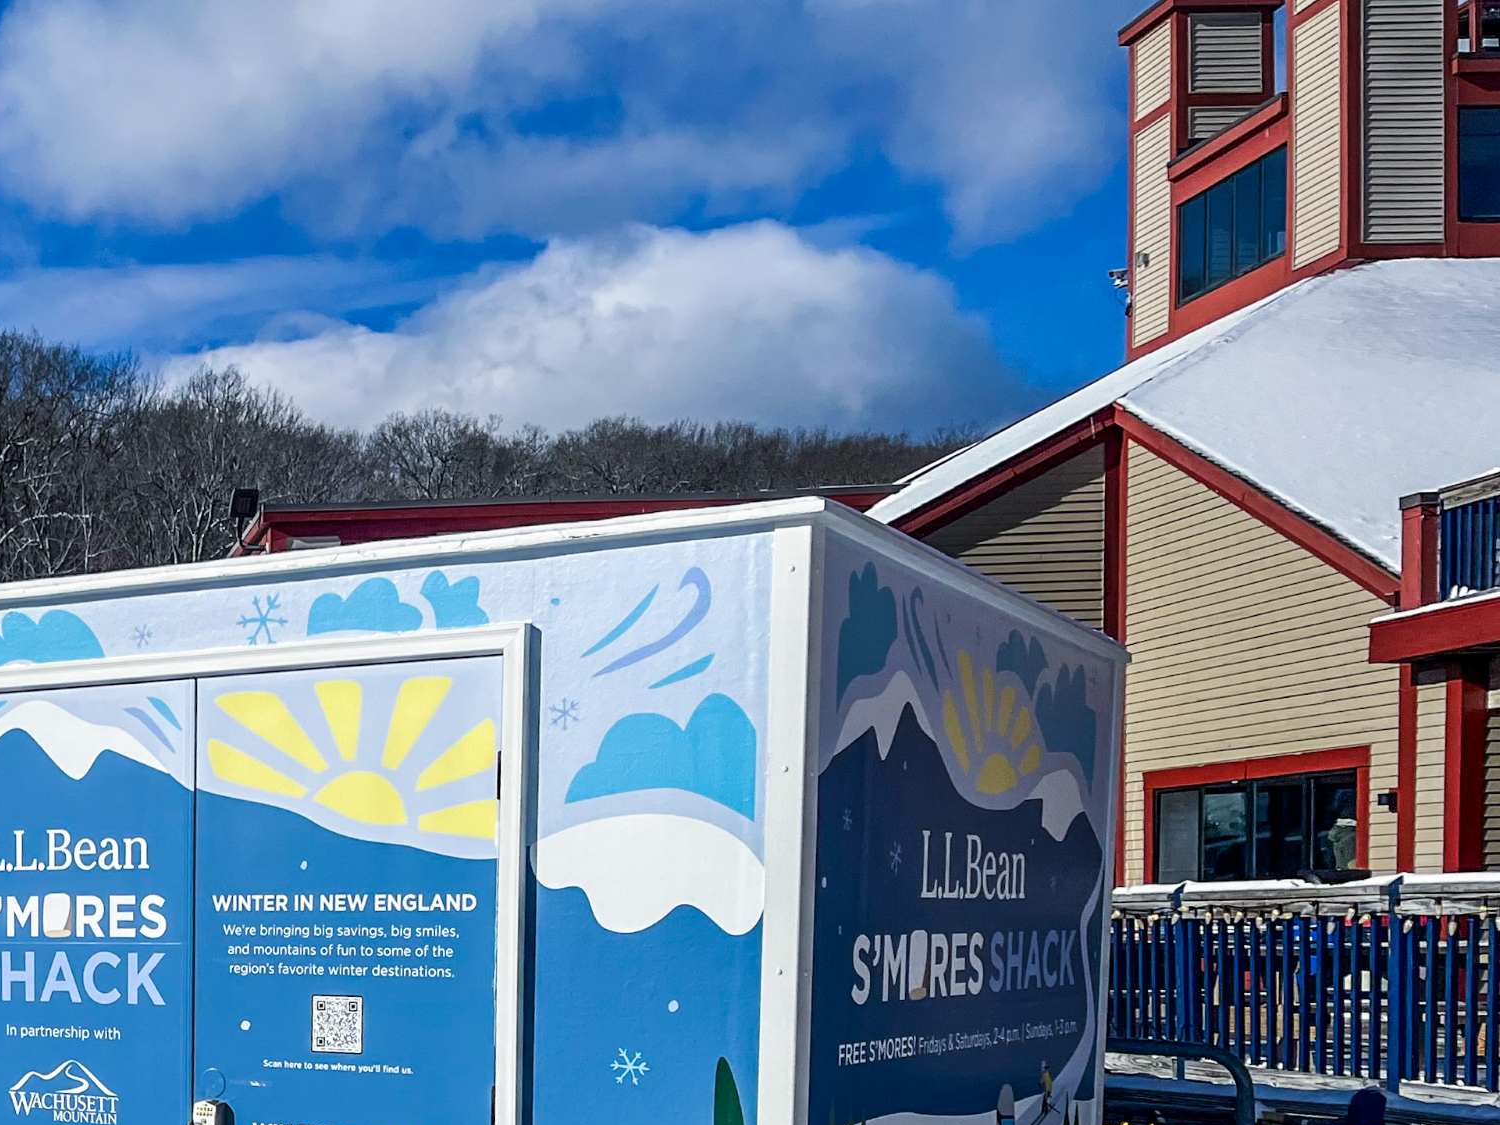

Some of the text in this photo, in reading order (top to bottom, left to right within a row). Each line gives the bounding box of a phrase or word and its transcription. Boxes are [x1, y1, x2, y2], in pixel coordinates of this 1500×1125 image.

[921, 830, 1026, 900] L.L.Bean
[212, 894, 477, 912] WINTER IN NEW ENGLAND
[223, 924, 460, 939] We're bringing big savings, big smiles,
[227, 944, 453, 958] and mountains of fun to some of the
[989, 930, 1077, 992] SHACK
[229, 962, 455, 978] region's favorite winter destinations.
[6, 1024, 121, 1040] In partnership with
[838, 1044, 866, 1067] FREE
[869, 1035, 917, 1062] S'MORES!
[918, 1036, 947, 1056] Fridays
[948, 1033, 954, 1051] &
[993, 1027, 1005, 1045] 2-4
[263, 1059, 414, 1074] Scan here to see where you'll find us.
[8, 1090, 119, 1116] WACHUSETT
[53, 1111, 117, 1125] MOUNTAIN
